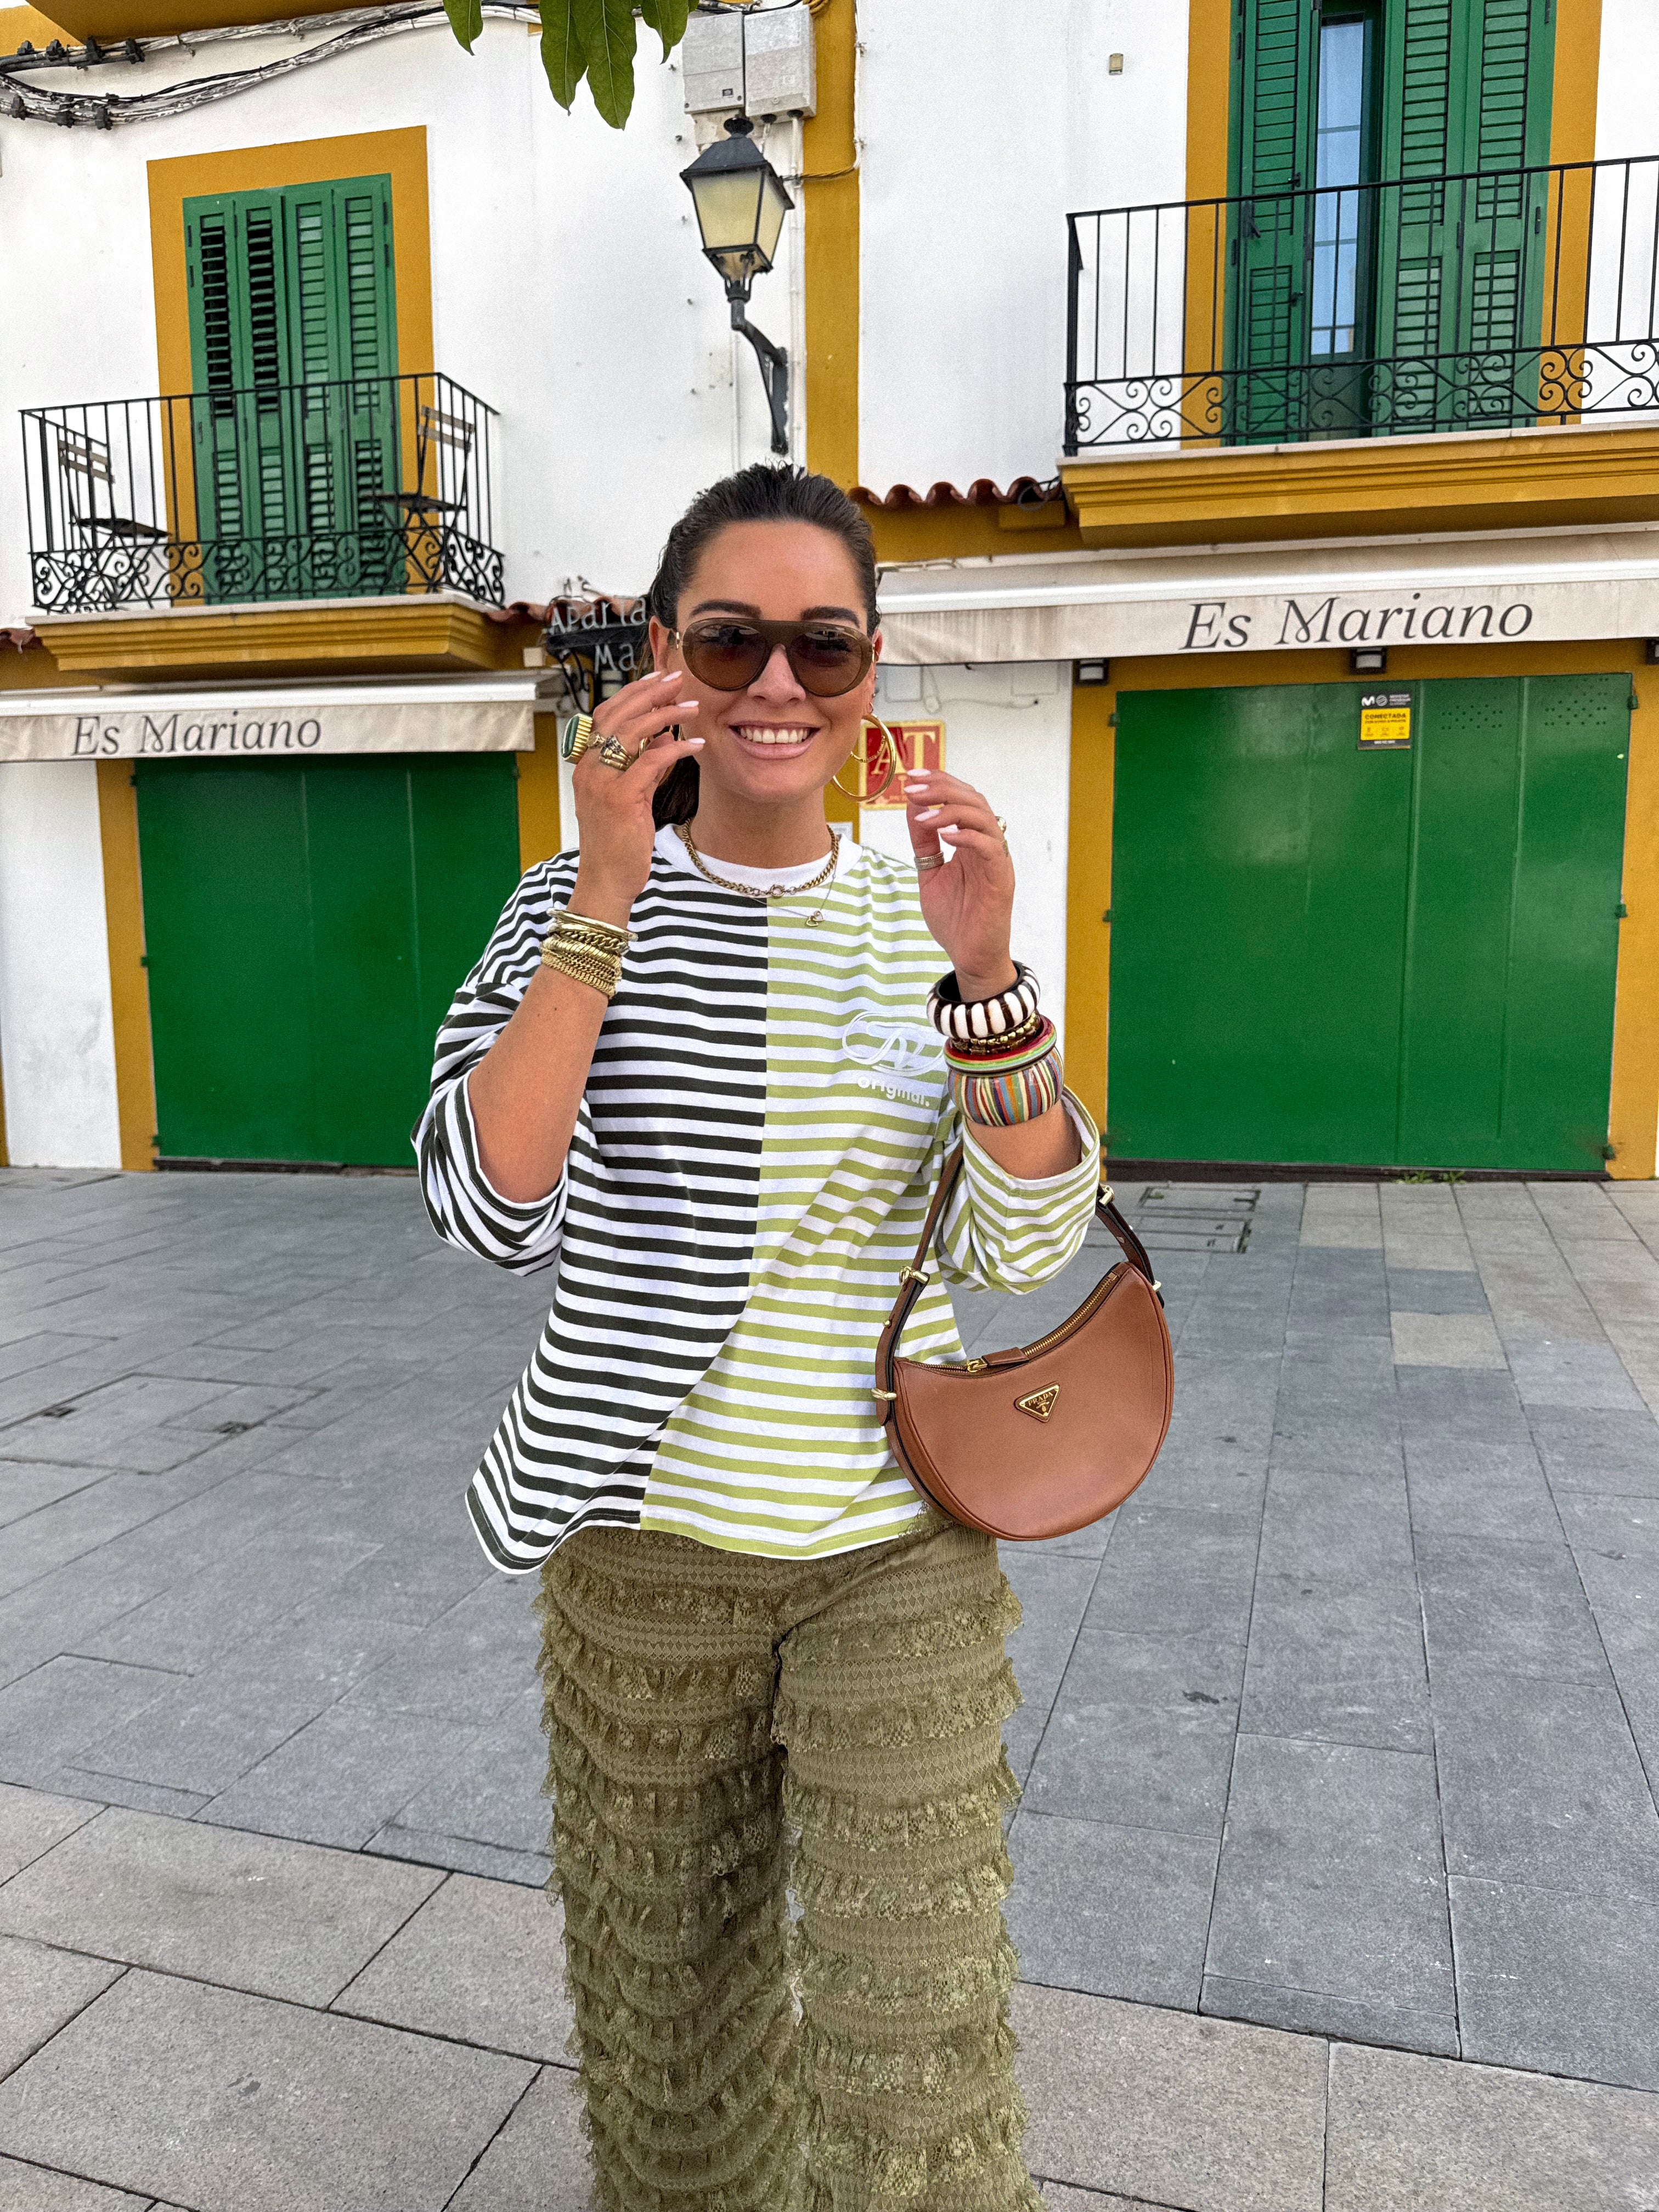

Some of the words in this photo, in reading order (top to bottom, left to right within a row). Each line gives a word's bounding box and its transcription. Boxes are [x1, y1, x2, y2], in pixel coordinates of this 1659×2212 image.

[1179, 602, 1251, 650] Es
[1273, 592, 1533, 646] Mariano
[594, 644, 637, 674] Ma
[71, 715, 120, 756] Es
[137, 710, 321, 754] Mariano
[871, 730, 936, 775] AT
[1028, 1391, 1053, 1406] PRADA
